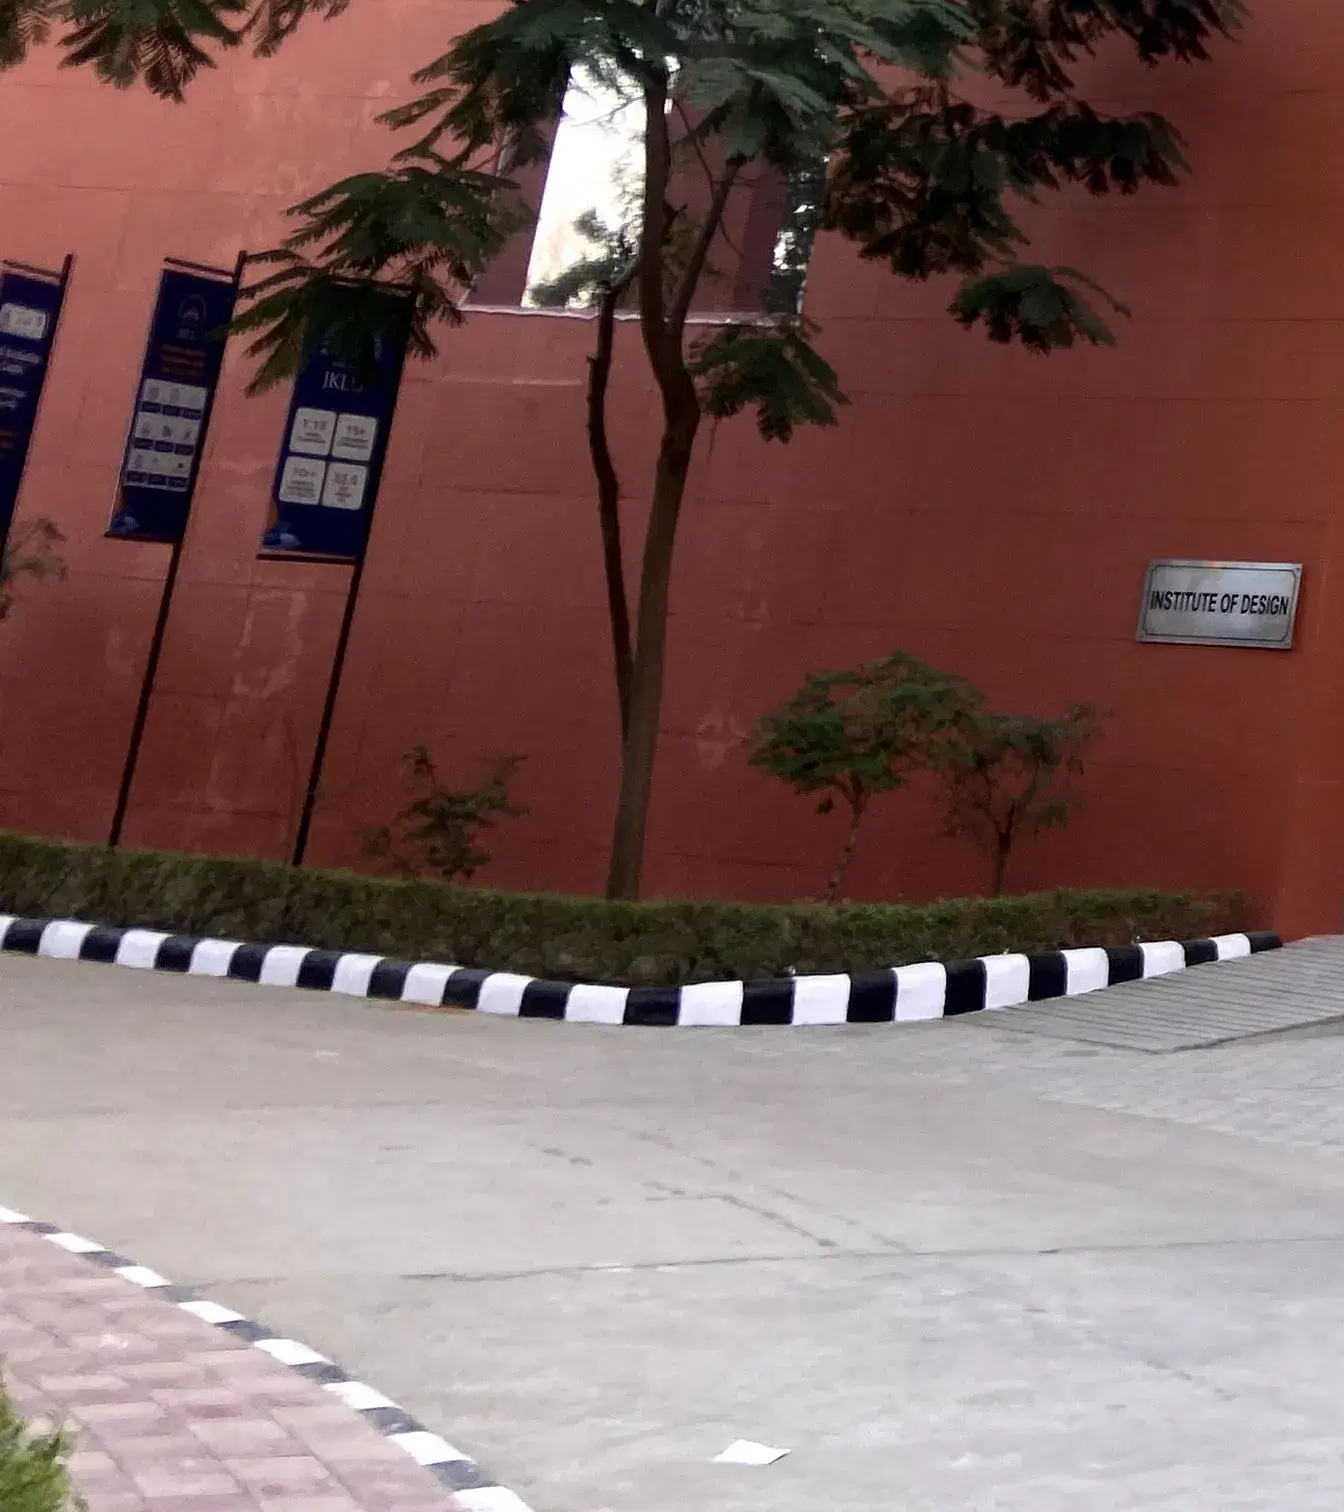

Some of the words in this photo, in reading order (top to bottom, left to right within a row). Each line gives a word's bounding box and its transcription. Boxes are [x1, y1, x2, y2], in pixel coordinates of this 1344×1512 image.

[1150, 590, 1218, 613] INSTITUTE
[1220, 593, 1241, 614] OF
[1241, 594, 1290, 616] DESIGN
